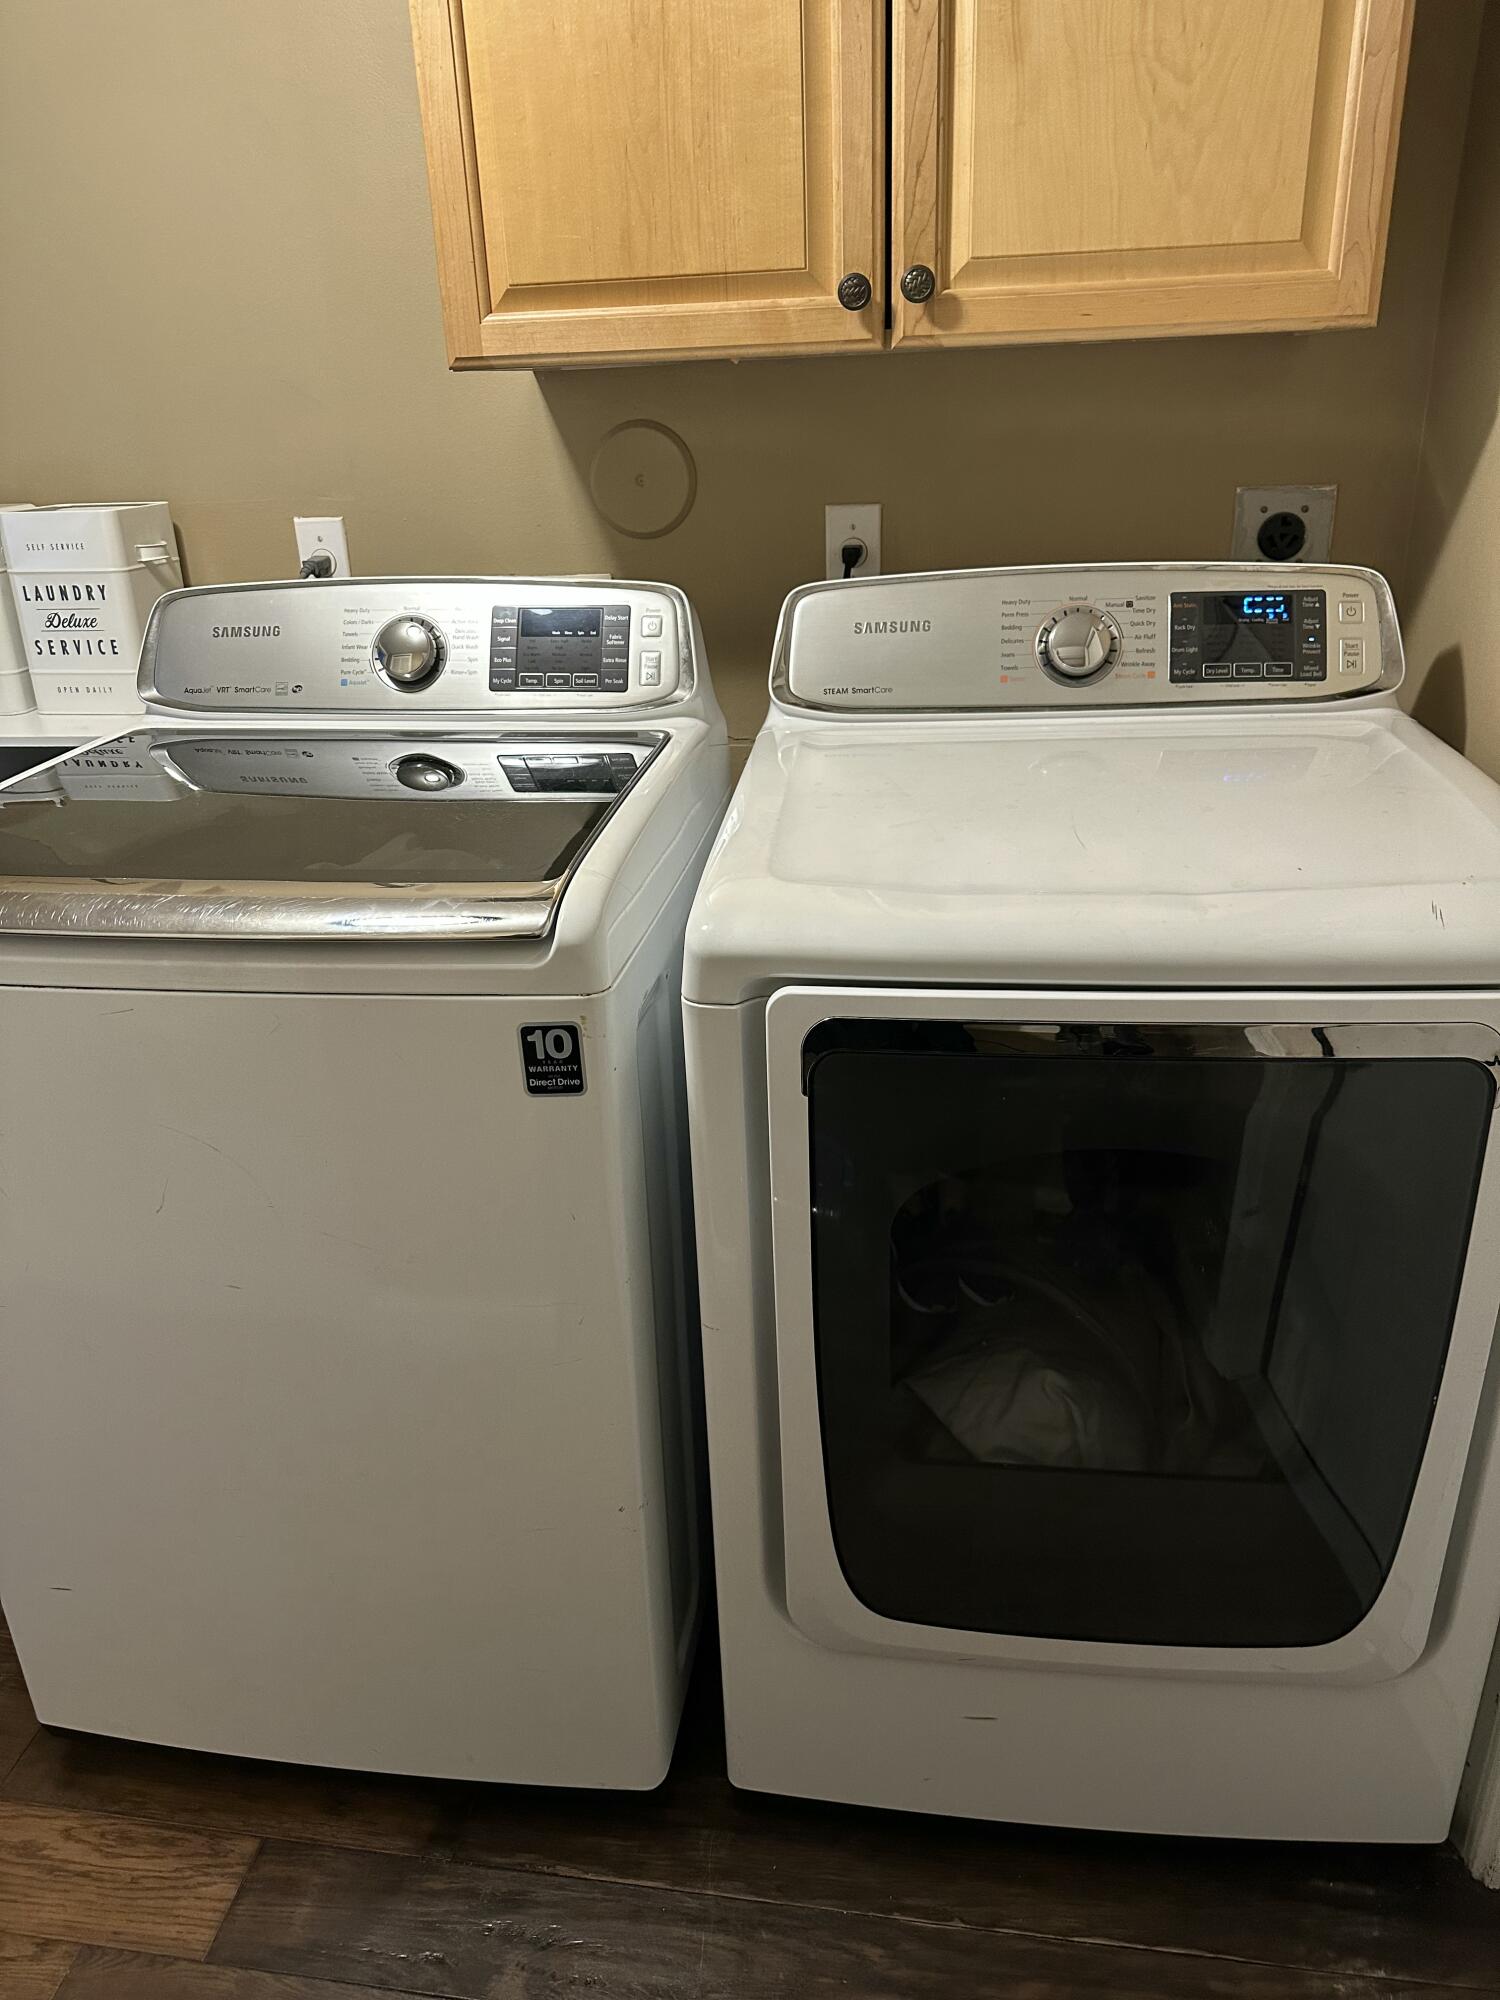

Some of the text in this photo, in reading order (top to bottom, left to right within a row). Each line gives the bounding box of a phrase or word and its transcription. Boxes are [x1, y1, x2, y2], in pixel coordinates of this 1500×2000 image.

[26, 542, 85, 551] SELF SERVICE
[22, 584, 107, 602] LAUNDRY
[44, 612, 99, 629] Deluxe
[212, 625, 281, 638] SAMSUNG
[854, 620, 931, 635] SAMSUNG
[34, 639, 119, 656] SERVICE
[57, 686, 113, 694] OPEN DAILY
[234, 686, 271, 694] SmartCare
[823, 686, 893, 695] STEAM SmartCare
[526, 1028, 573, 1060] 10
[528, 1065, 578, 1073] WARRANTY
[529, 1077, 581, 1087] Direct Drive
